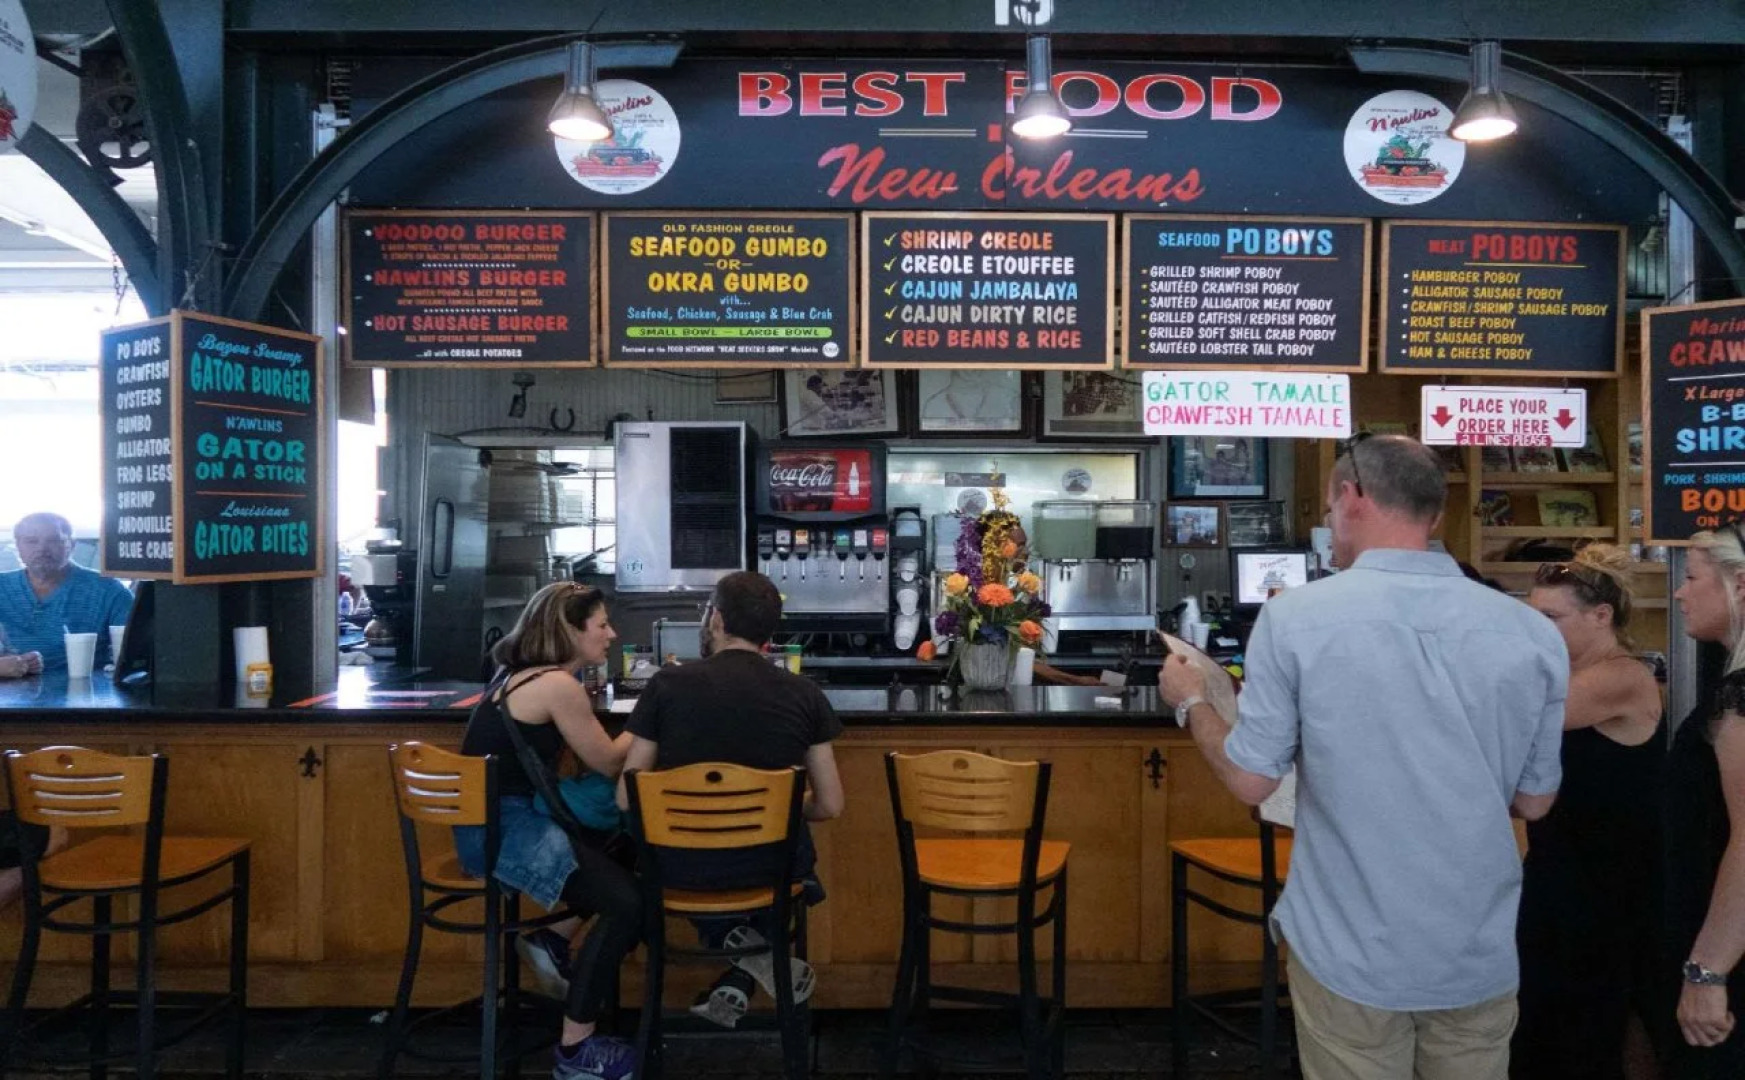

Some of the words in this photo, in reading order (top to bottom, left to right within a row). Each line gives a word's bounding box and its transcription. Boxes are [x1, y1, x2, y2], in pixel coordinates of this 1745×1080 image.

[737, 71, 966, 117] BEST
[1006, 70, 1283, 121] FOOD
[817, 142, 956, 203] New
[981, 145, 1205, 202] Orleans
[374, 224, 465, 241] VOODOO
[475, 224, 567, 241] BURGER
[663, 224, 685, 233] OLD
[691, 224, 742, 233] FASHION
[747, 224, 795, 233] CREOLE
[629, 236, 736, 257] SEAFOOD
[745, 236, 827, 257] GUMBO
[901, 230, 973, 250] SHRIMP
[980, 231, 1053, 250] CREOLE
[1158, 232, 1220, 248] SEAFOOD
[1428, 239, 1465, 254] MEAT
[901, 255, 973, 274] CREOLE
[982, 256, 1075, 275] ETOUFFEE
[1150, 265, 1195, 278] GRILLED
[1200, 266, 1241, 279] SHRIMP
[1244, 267, 1282, 279] POBOY
[480, 270, 567, 286] BURGER
[648, 272, 714, 293] OKRA
[724, 272, 809, 293] GUMBO
[1411, 270, 1480, 283] HAMBURGER
[1483, 271, 1521, 284] POBOY
[901, 280, 962, 300] CAJUN
[970, 281, 1078, 301] JAMBALAYA
[1202, 281, 1258, 294] CRAWFISH
[1262, 283, 1300, 295] POBOY
[1411, 286, 1469, 298] ALLIGATOR
[1473, 287, 1523, 299] SAUSAGE
[1526, 288, 1564, 300] POBOY
[1201, 297, 1259, 310] ALLIGATOR
[1263, 298, 1292, 310] MEAT
[1295, 299, 1333, 311] POBOY
[1518, 303, 1567, 316] SAUSAGE
[1571, 304, 1608, 317] POBOY
[374, 315, 406, 331] HOT
[412, 315, 491, 331] SAUSAGE
[497, 315, 568, 331] BURGER
[627, 306, 673, 322] Seafood,
[677, 306, 721, 322] Chicken,
[725, 307, 765, 323] Sausage
[770, 308, 778, 320] &
[782, 307, 805, 320] Blue
[809, 307, 832, 320] Crab
[901, 305, 962, 324] CAJUN
[970, 305, 1026, 324] DIRTY
[1032, 306, 1077, 324] RICE
[1149, 312, 1194, 325] GRILLED
[1299, 314, 1337, 327] POBOY
[1410, 316, 1445, 328] ROAST
[1449, 317, 1476, 328] BEEF
[1479, 317, 1516, 330] POBOY
[639, 328, 678, 336] SMALL
[682, 328, 718, 336] BOWL
[739, 328, 780, 336] LARGE
[785, 328, 820, 336] BOWL
[902, 330, 939, 348] RED
[947, 330, 1009, 348] BEANS
[1016, 331, 1029, 347] &
[1037, 330, 1081, 349] RICE
[1149, 327, 1194, 339] GRILLED
[1197, 327, 1226, 340] SOFT
[1229, 328, 1261, 340] SHELL
[1265, 329, 1295, 341] CRAB
[1299, 329, 1337, 341] POBOY
[1409, 331, 1430, 343] HOT
[1434, 331, 1483, 344] SAUSAGE
[1487, 332, 1525, 345] POBOY
[116, 342, 130, 361] PO
[133, 336, 161, 357] BOYS
[450, 349, 480, 357] CREOLE
[483, 349, 522, 357] POTATOES
[1200, 343, 1248, 355] LOBSTER
[1252, 343, 1273, 355] TAIL
[1277, 344, 1314, 356] POBOY
[1409, 346, 1433, 359] HAM
[1437, 347, 1446, 359] &
[1450, 347, 1492, 360] CHEESE
[1495, 348, 1533, 361] POBOY
[1669, 339, 1745, 368] CRAW
[116, 360, 170, 386] CRAWFISH
[190, 350, 246, 393] GATOR
[251, 366, 311, 404] BURGER
[116, 388, 162, 410] OYSTERS
[1147, 381, 1229, 401] GATOR
[1252, 382, 1344, 404] TAMALE
[1684, 386, 1697, 401] X
[1700, 386, 1745, 402] Large
[1459, 398, 1504, 413] PLACE
[1509, 399, 1547, 414] YOUR
[1702, 403, 1745, 423] B-B
[116, 414, 152, 434] GUMBO
[225, 415, 283, 433] N'AWLINS
[1146, 405, 1253, 425] CRAWFISH
[1258, 406, 1344, 428] TAMALE
[1458, 418, 1506, 433] ORDER
[1512, 419, 1550, 434] HERE
[116, 437, 171, 459] ALLIGATOR
[196, 432, 306, 462] GATOR
[1512, 434, 1548, 446] PLEASE
[1676, 426, 1745, 453] SHR
[117, 466, 143, 484] FROG
[146, 464, 173, 482] LEGS
[195, 461, 225, 480] ON
[232, 463, 246, 479] A
[254, 464, 306, 484] STICK
[769, 463, 835, 487] Coca-Cola
[1664, 473, 1696, 485] PORK
[117, 490, 156, 509] SHRIMP
[1681, 488, 1745, 512] BOU
[220, 500, 290, 518] Louisiana
[118, 516, 173, 535] ANDOUILLE
[1696, 516, 1719, 526] ON
[194, 520, 255, 559] GATOR
[262, 520, 309, 557] BITES
[118, 541, 143, 559] BLUE
